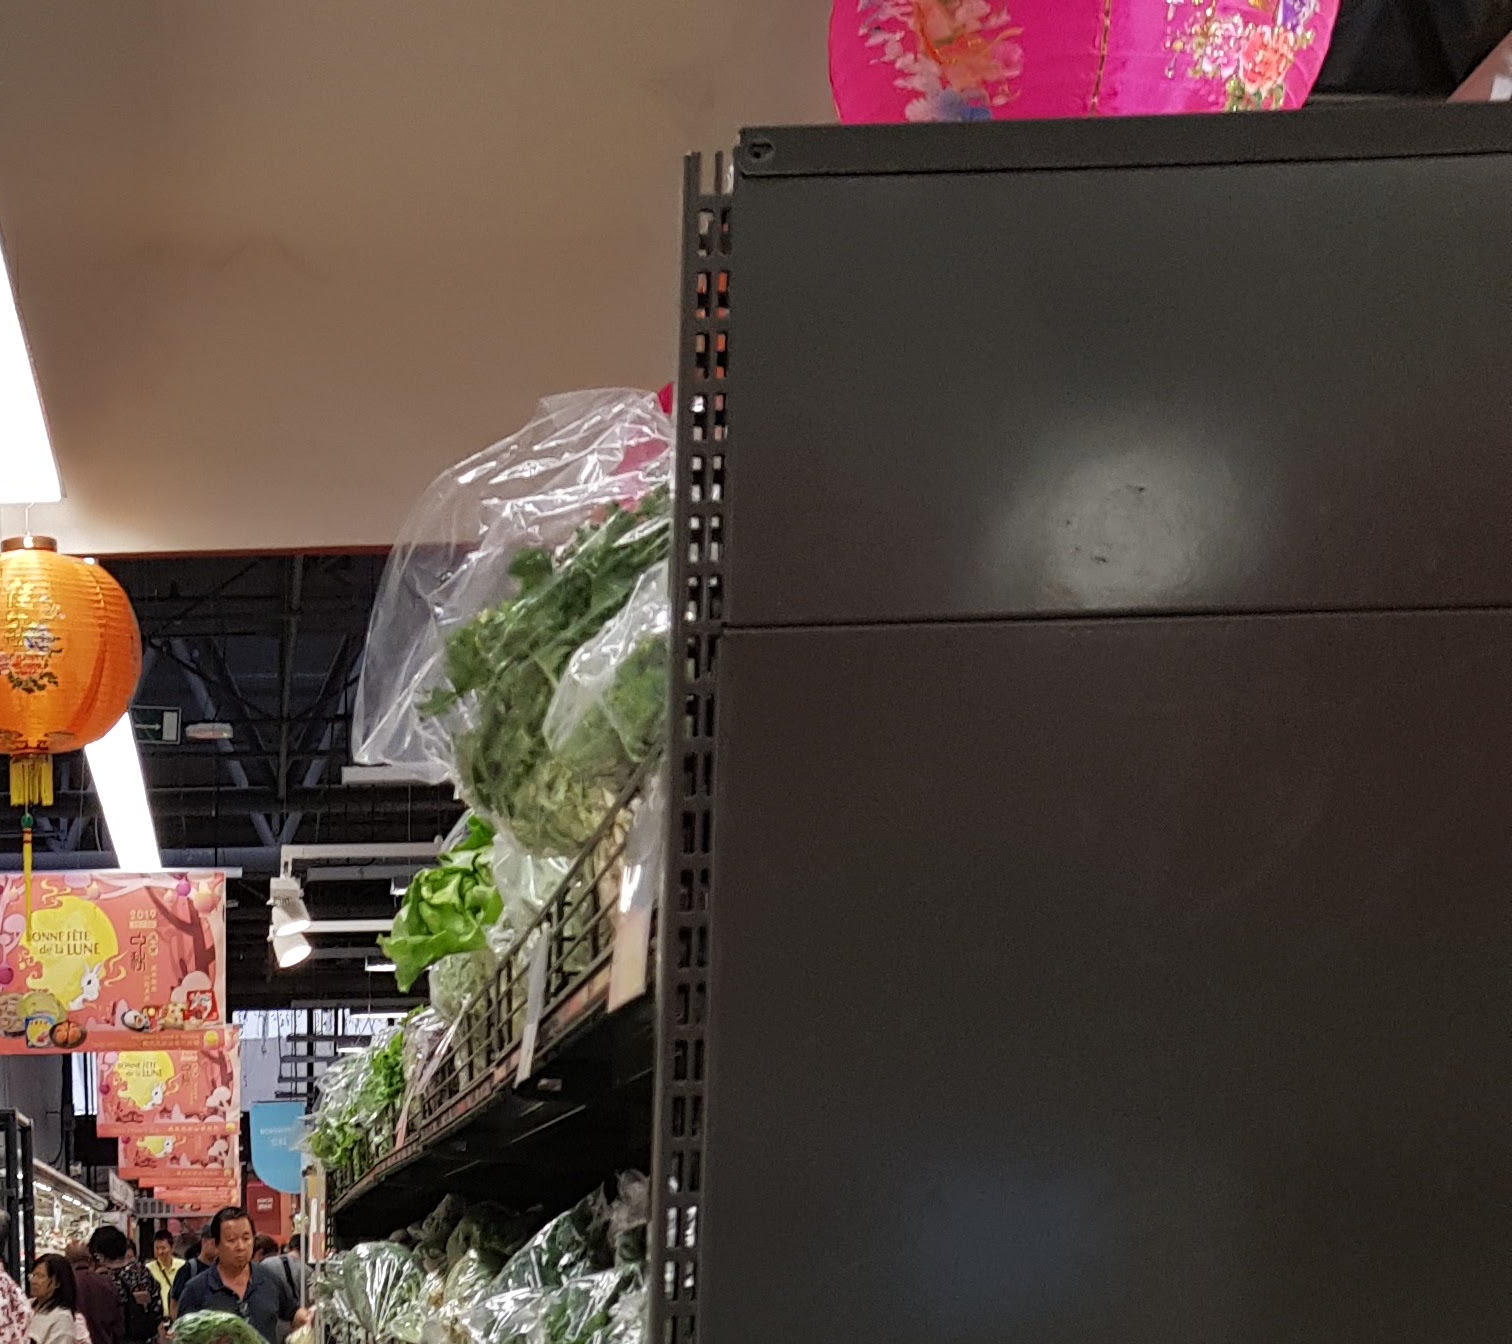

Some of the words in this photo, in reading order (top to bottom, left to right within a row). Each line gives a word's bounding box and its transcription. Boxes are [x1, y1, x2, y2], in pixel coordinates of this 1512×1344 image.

[129, 909, 157, 921] 2019
[29, 931, 65, 942] ONNE
[66, 928, 90, 942] FÊTE
[67, 942, 100, 955] LUNE
